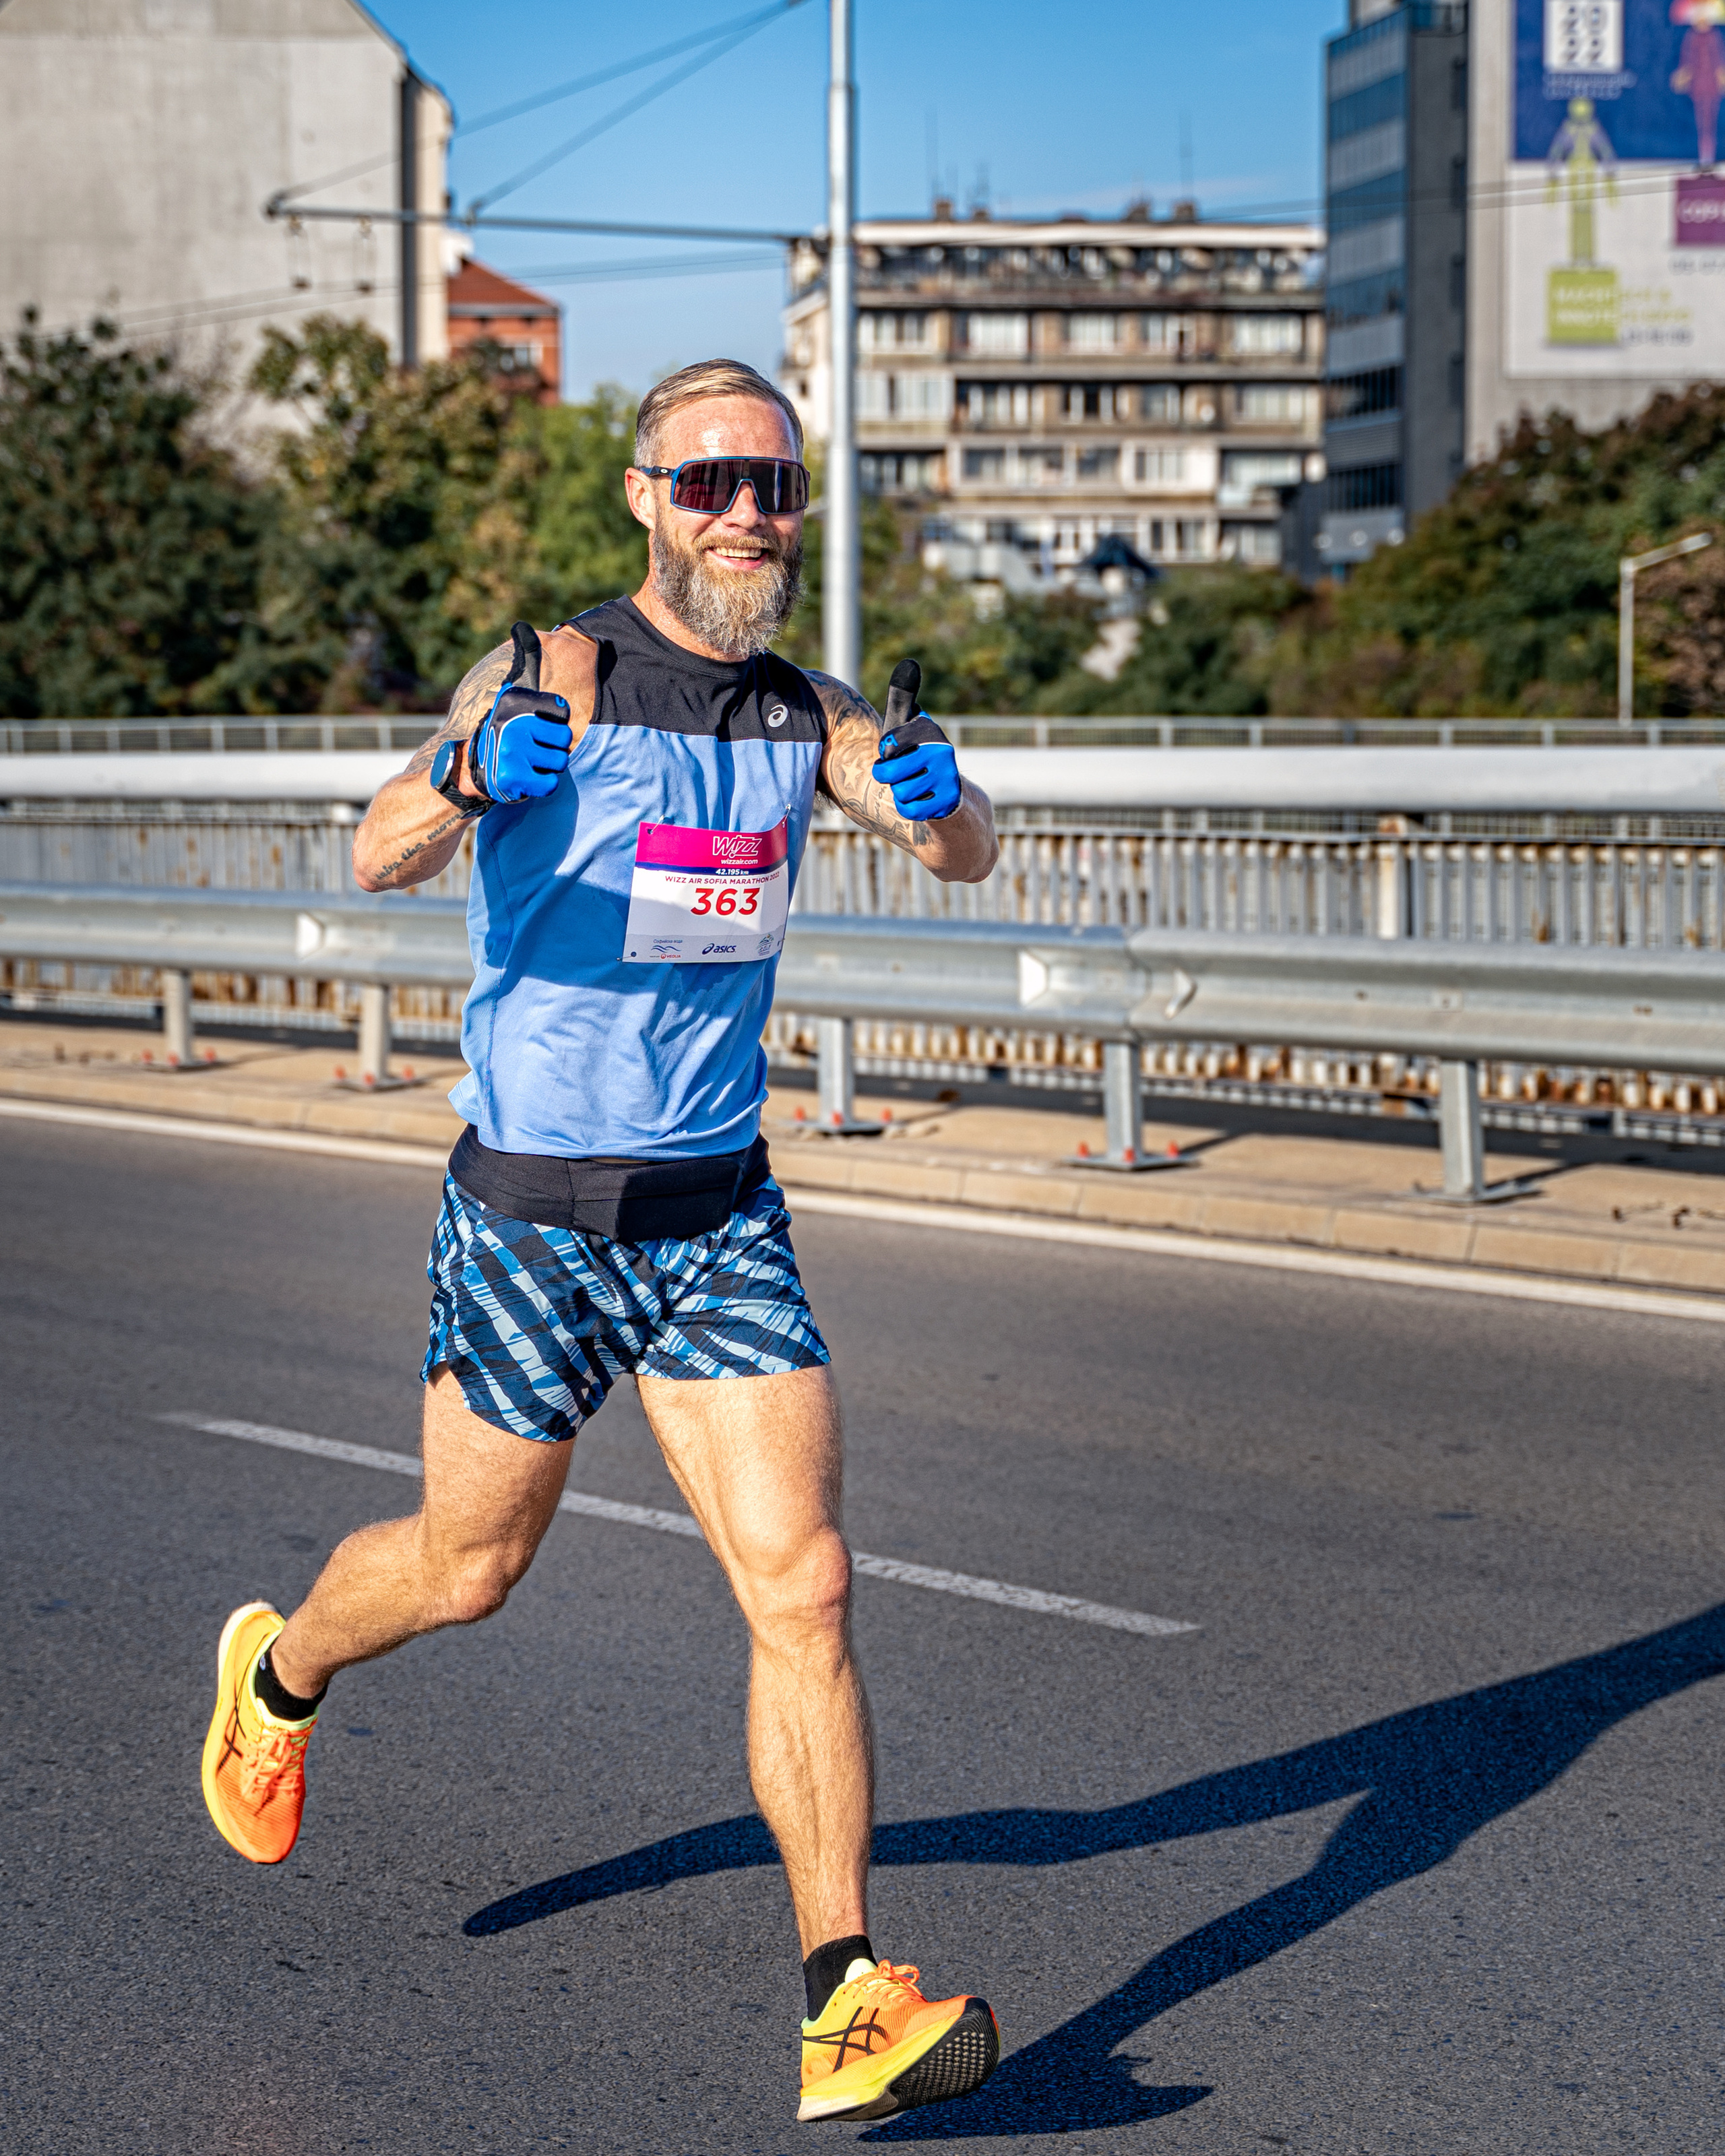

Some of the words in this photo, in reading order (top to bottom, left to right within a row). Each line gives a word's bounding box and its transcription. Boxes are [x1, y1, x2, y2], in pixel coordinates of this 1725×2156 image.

[665, 875, 687, 883] WIZZ
[729, 876, 769, 885] MARATHON
[691, 887, 760, 915] 363
